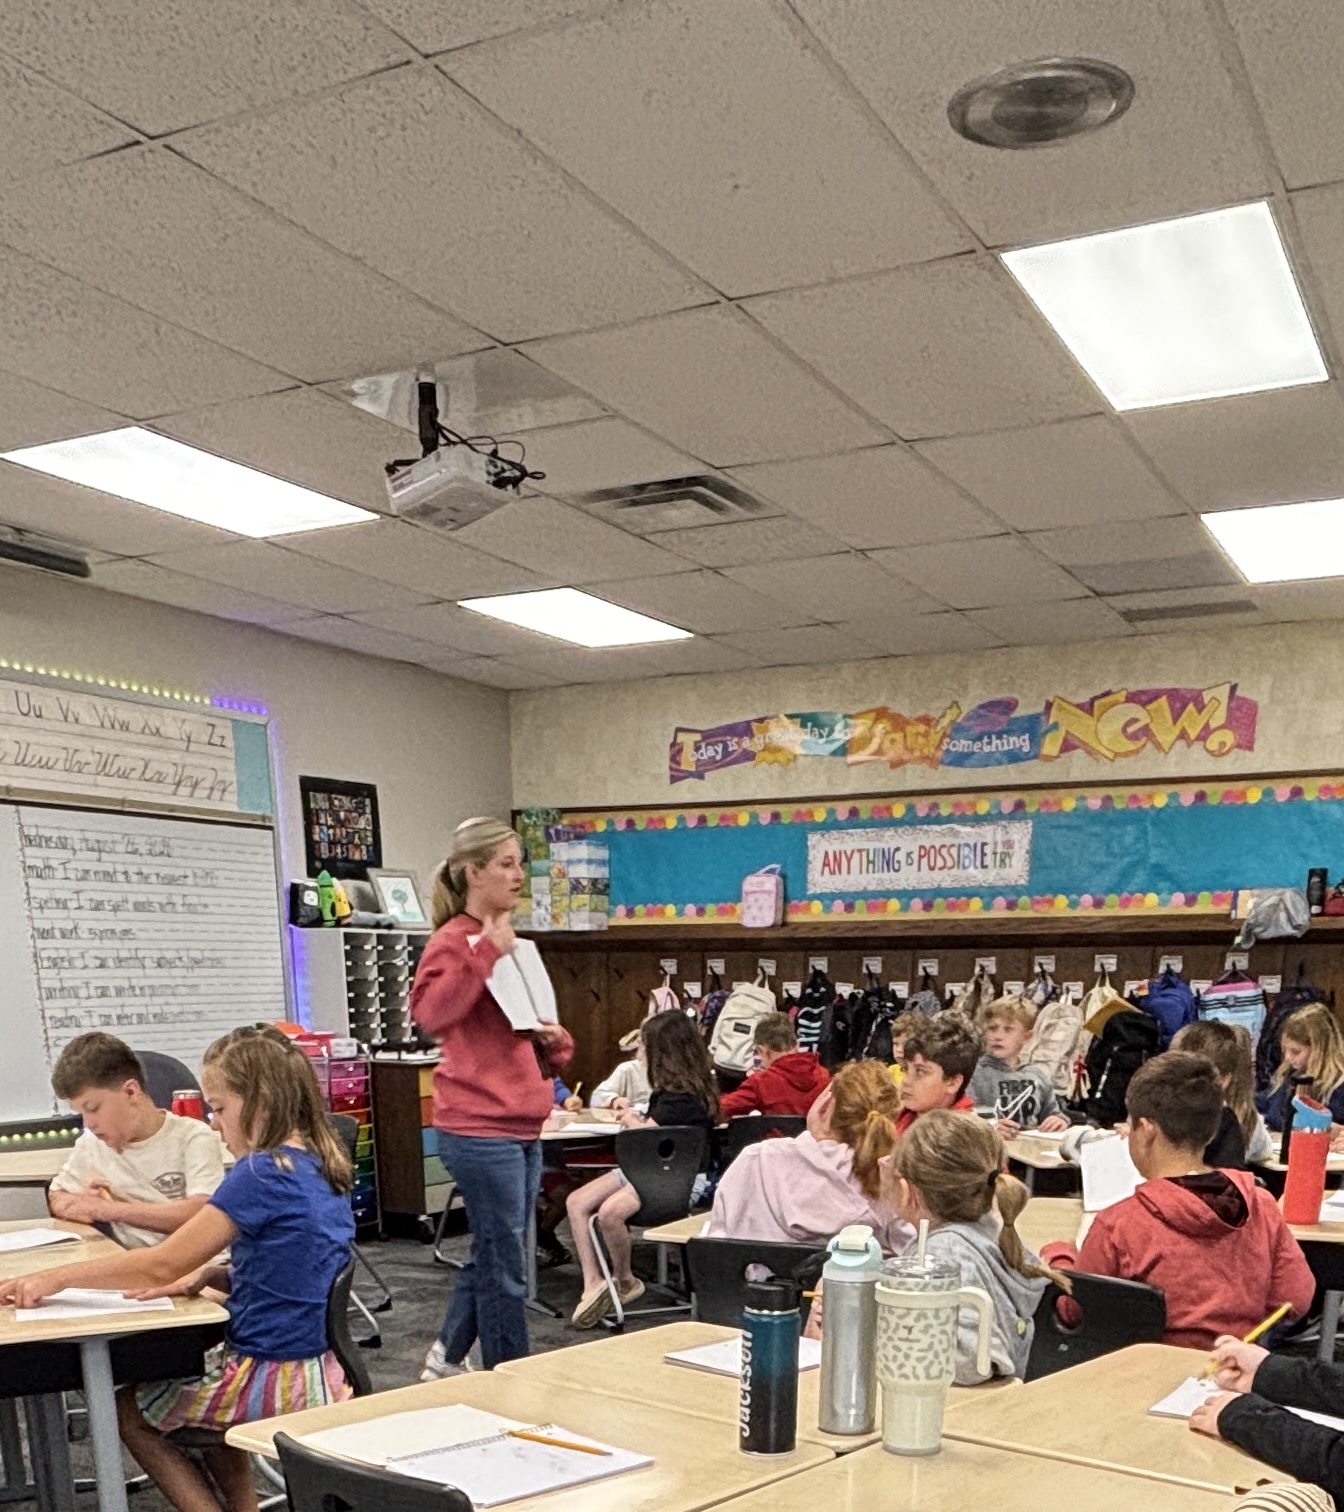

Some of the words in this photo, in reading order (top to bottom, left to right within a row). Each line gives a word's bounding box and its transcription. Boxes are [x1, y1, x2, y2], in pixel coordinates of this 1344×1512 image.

[14, 690, 43, 720] Uu
[56, 697, 80, 724] Vv
[93, 703, 131, 732] Ww
[141, 714, 162, 738] Xx
[173, 716, 193, 751] Yy
[206, 723, 226, 748] Zz
[675, 731, 724, 772] Today
[728, 736, 739, 752] is
[741, 736, 750, 748] a
[806, 721, 829, 741] day
[942, 732, 1030, 753] something
[821, 847, 901, 876] ANYTHING
[906, 851, 915, 866] IS
[917, 842, 989, 872] POSSIBLE
[991, 851, 1015, 869] TRY
[739, 1329, 753, 1437] Jackson
